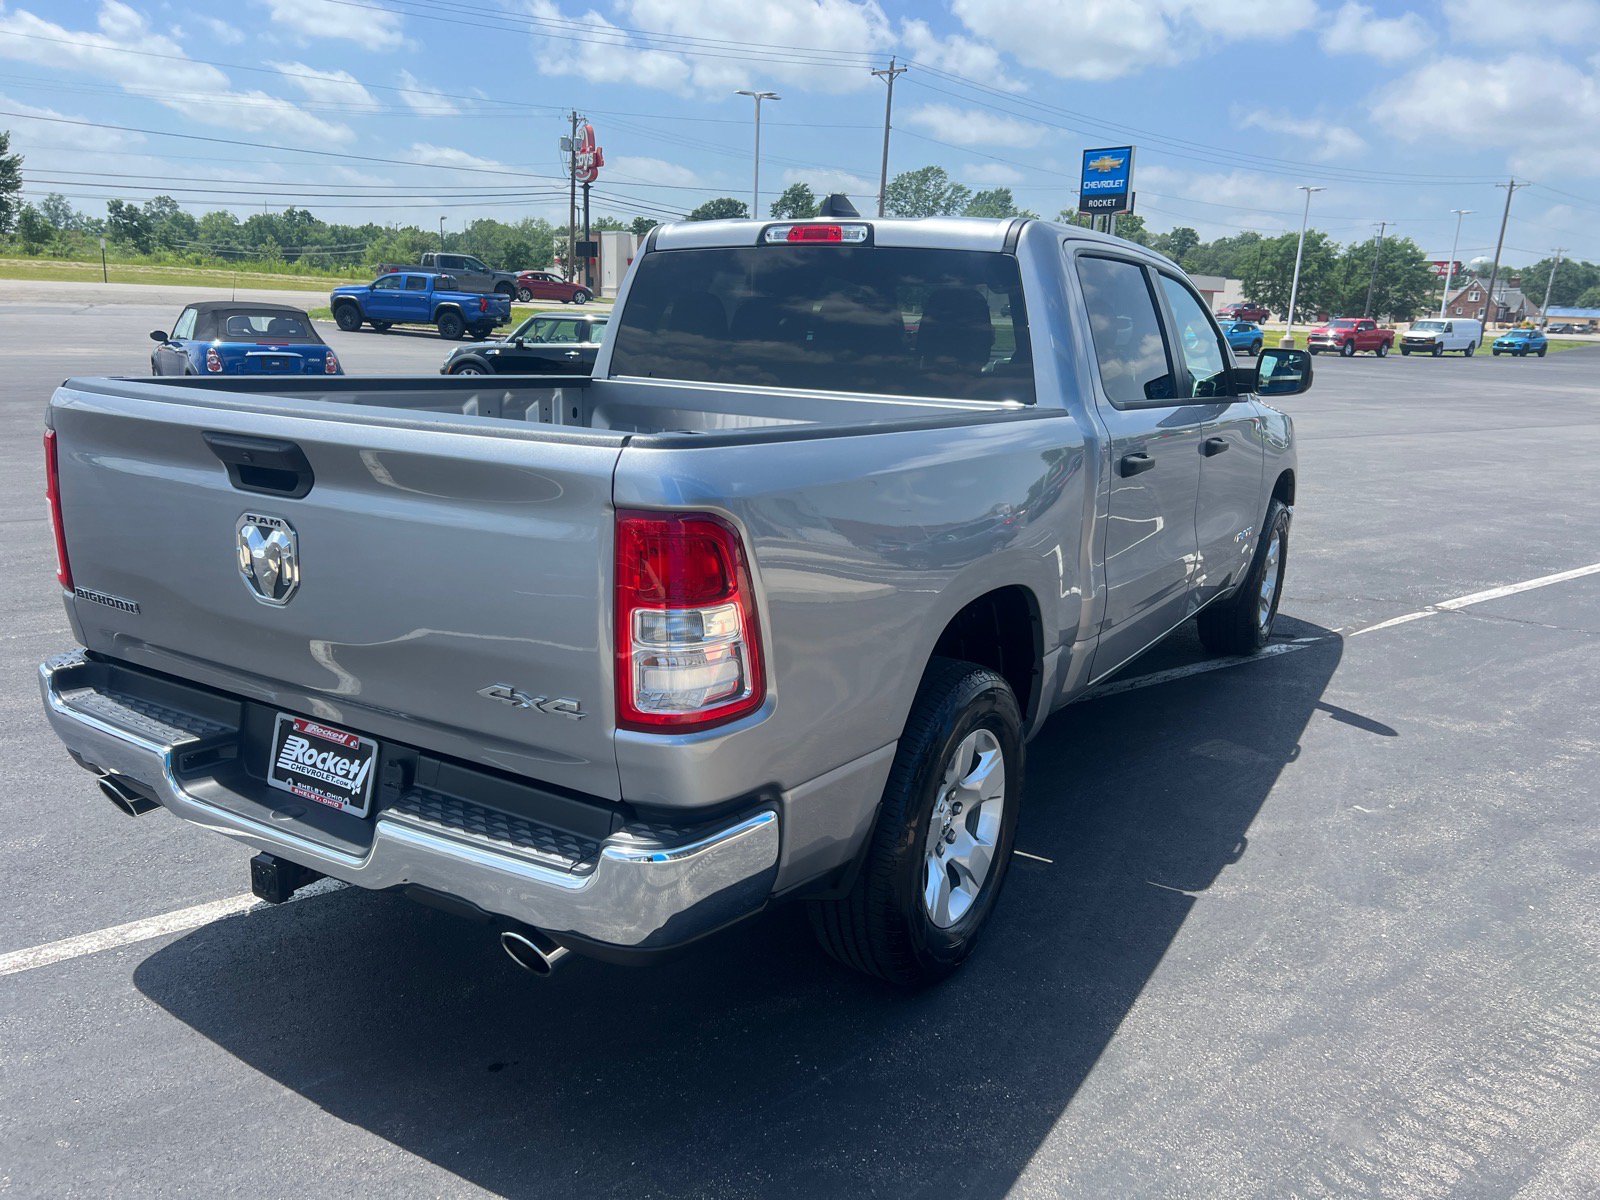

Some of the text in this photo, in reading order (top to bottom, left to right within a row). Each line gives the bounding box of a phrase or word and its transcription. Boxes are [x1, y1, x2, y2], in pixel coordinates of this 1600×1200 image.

[1083, 179, 1125, 189] CHEVROLET
[1088, 199, 1116, 207] ROCKET
[246, 515, 281, 527] RAM
[75, 587, 140, 614] BIGHORN
[326, 791, 343, 802] OHIO
[323, 798, 340, 808] OHIO
